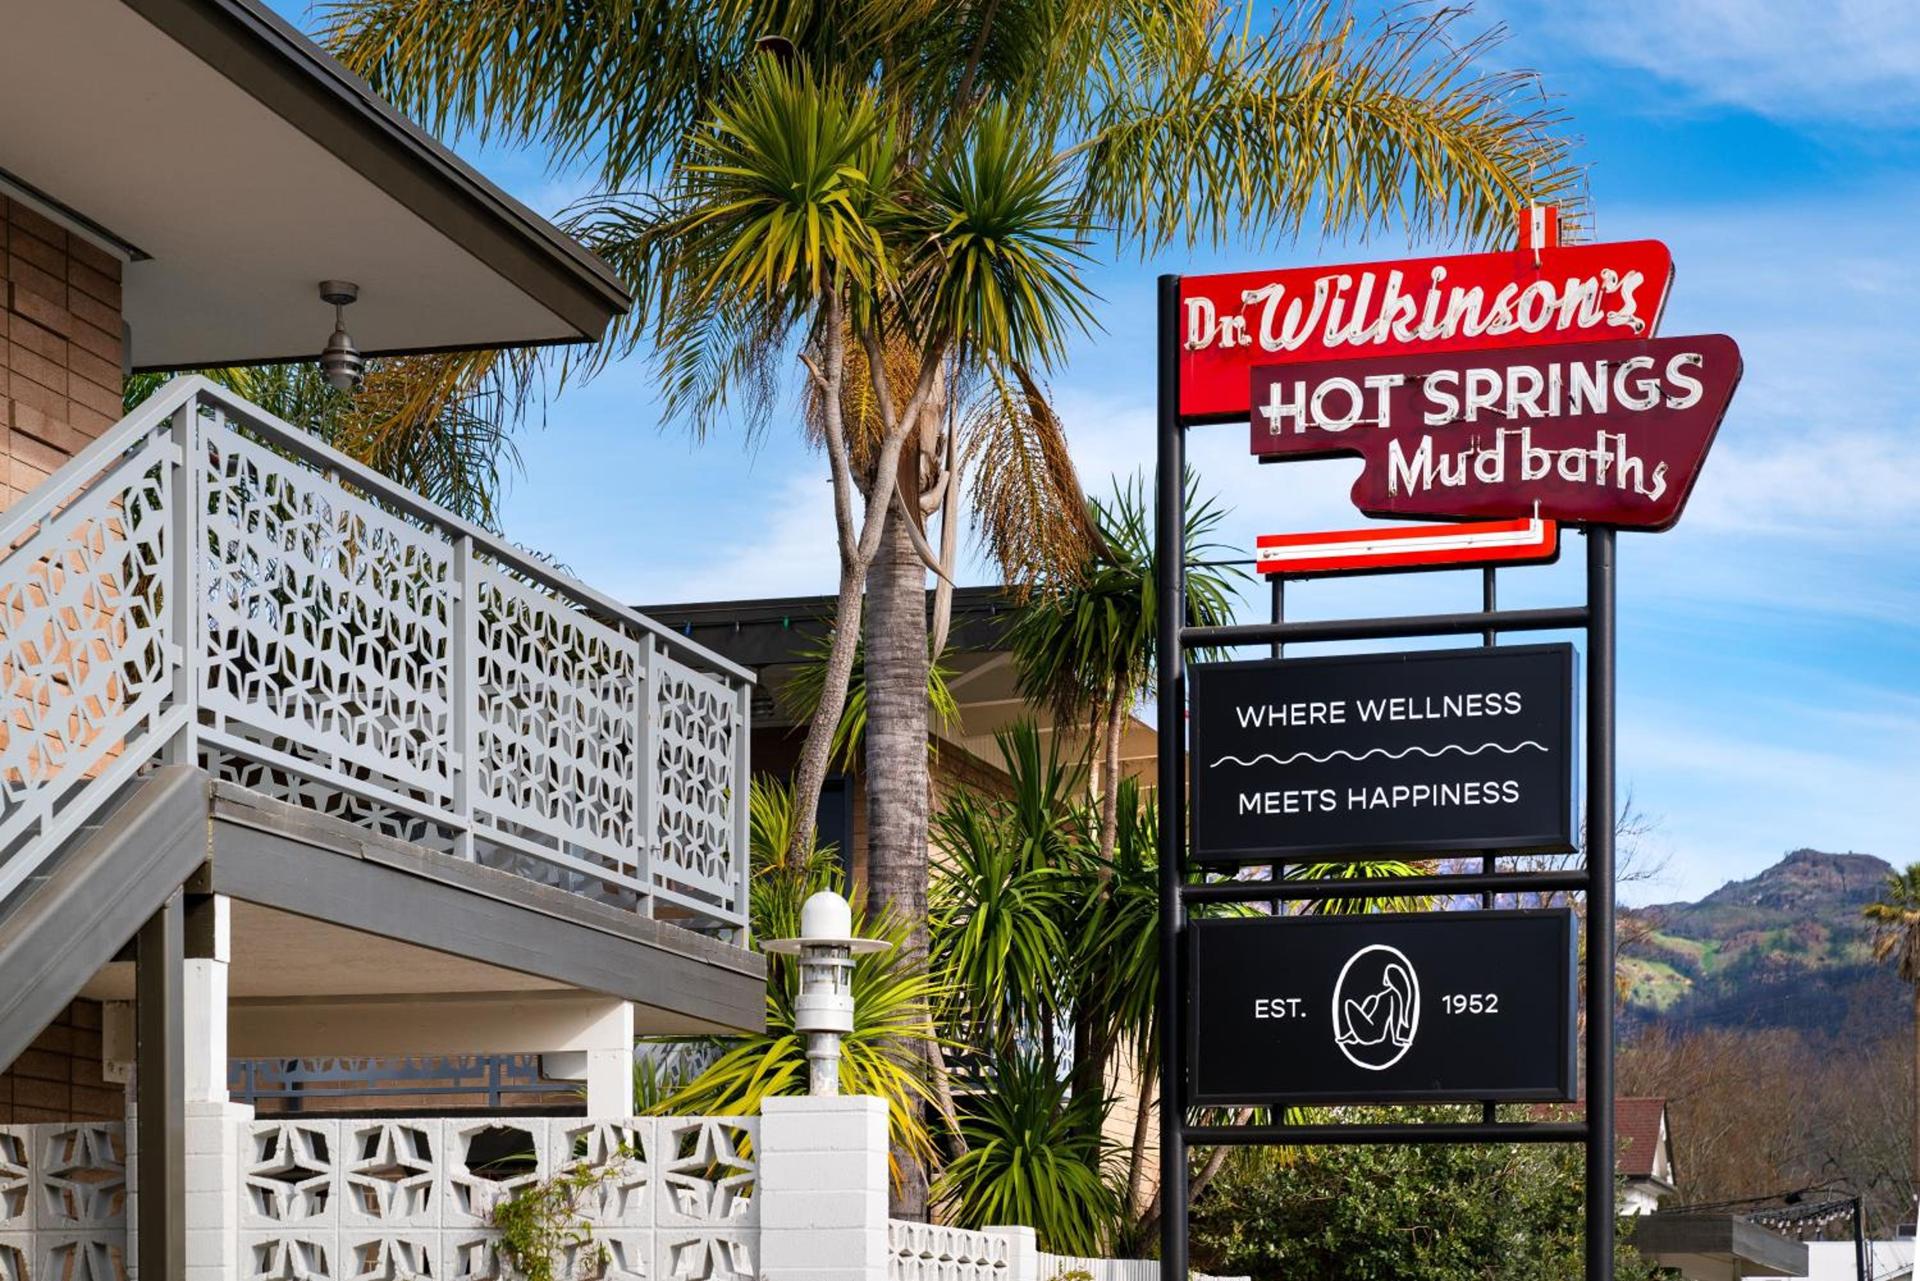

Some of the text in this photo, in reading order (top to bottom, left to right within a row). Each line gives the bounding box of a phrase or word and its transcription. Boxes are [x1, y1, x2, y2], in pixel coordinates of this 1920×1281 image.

[1241, 265, 1645, 352] Wilkinson's
[1259, 352, 1703, 435] HOT SPRINGS
[1236, 691, 1522, 729] WHERE WELLNESS
[1238, 780, 1520, 816] MEETS HAPPINESS
[1254, 993, 1499, 1020] EST. 1952
